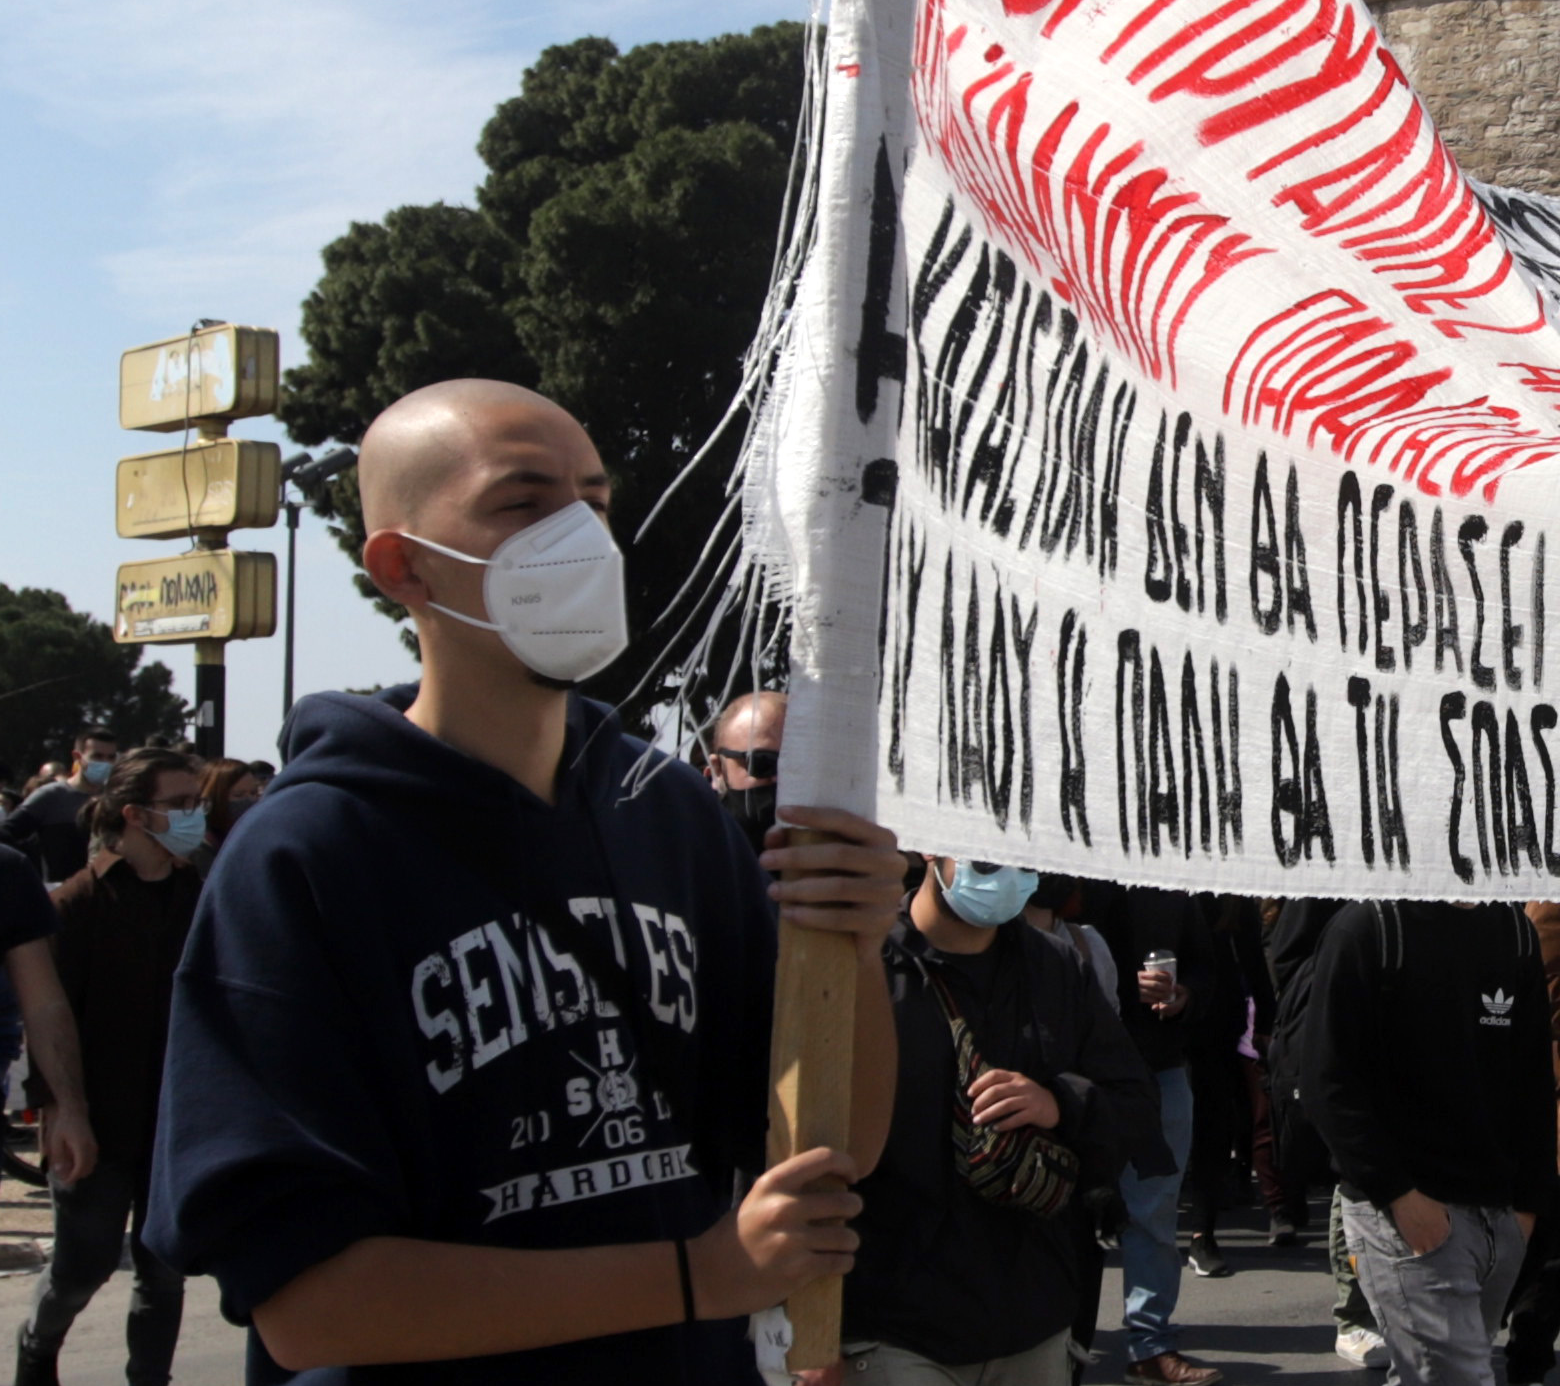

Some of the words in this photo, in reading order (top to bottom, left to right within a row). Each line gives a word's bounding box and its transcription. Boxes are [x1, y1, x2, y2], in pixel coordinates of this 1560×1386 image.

[1144, 406, 1229, 626] ΔΕΝ
[1248, 448, 1319, 645] ΘΑ
[1337, 469, 1547, 695] ΠΕΡΑΣΕΙ
[938, 543, 1039, 843] ΛΑΟΥ
[1055, 605, 1093, 850] Η
[1115, 627, 1244, 861] ΠΑΛΗ
[1270, 670, 1337, 871] ΘΑ
[1346, 675, 1412, 875] ΤΗ
